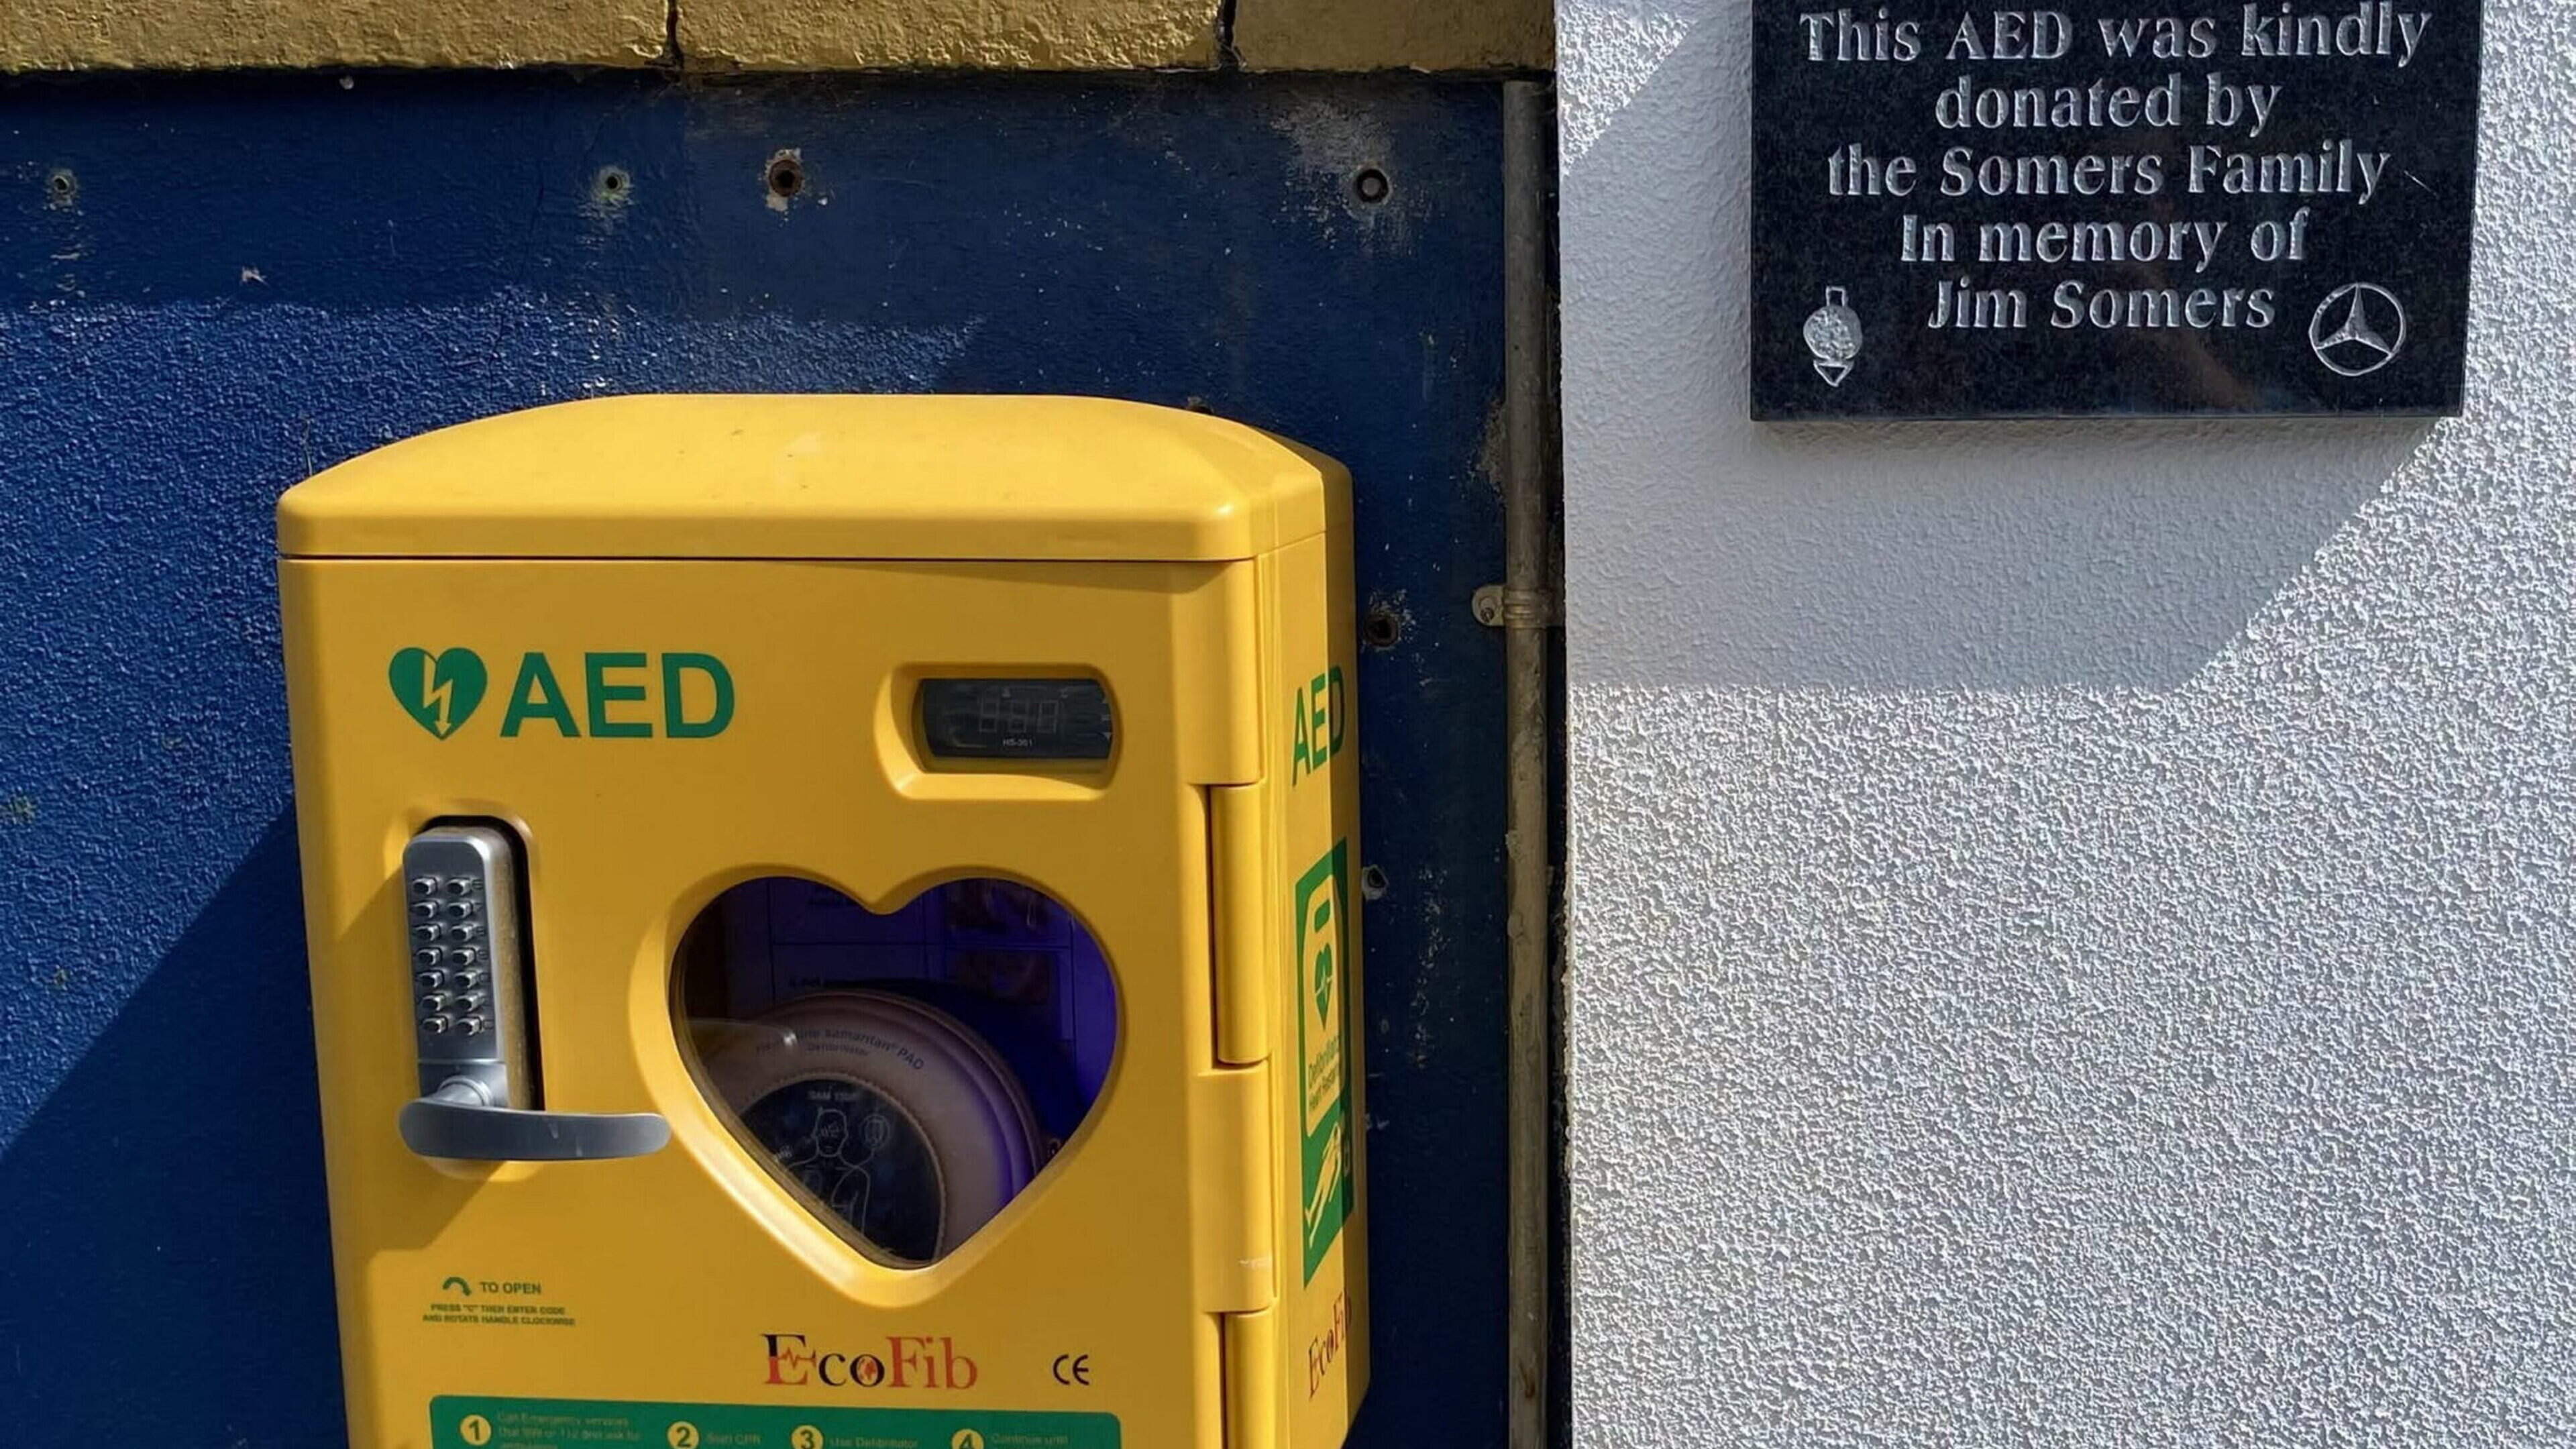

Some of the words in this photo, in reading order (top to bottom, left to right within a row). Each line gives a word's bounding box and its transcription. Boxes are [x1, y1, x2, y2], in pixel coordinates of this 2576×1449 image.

[1799, 7, 1921, 62] This
[1945, 11, 2072, 60] AED
[2098, 17, 2216, 59] was
[2241, 1, 2431, 68] kindly
[1935, 73, 2180, 129] donated
[2206, 72, 2281, 138] by
[1827, 144, 1916, 197] the
[1940, 147, 2162, 197] Somers
[2188, 140, 2390, 205] Family
[1900, 215, 1955, 262] In
[1978, 221, 2227, 274] memory
[2250, 207, 2310, 262] of
[1927, 276, 2027, 329] Jim
[2050, 280, 2274, 329] Somers
[499, 651, 735, 739] AED
[1292, 665, 1345, 787] AED
[897, 1047, 925, 1070] PAD
[479, 1281, 499, 1293] TO
[502, 1282, 541, 1295] OPEN
[759, 1333, 978, 1390] EcoFib
[469, 1419, 480, 1441] 1
[677, 1426, 692, 1448] 2
[800, 1429, 816, 1449] 3
[958, 1433, 974, 1449] 4
